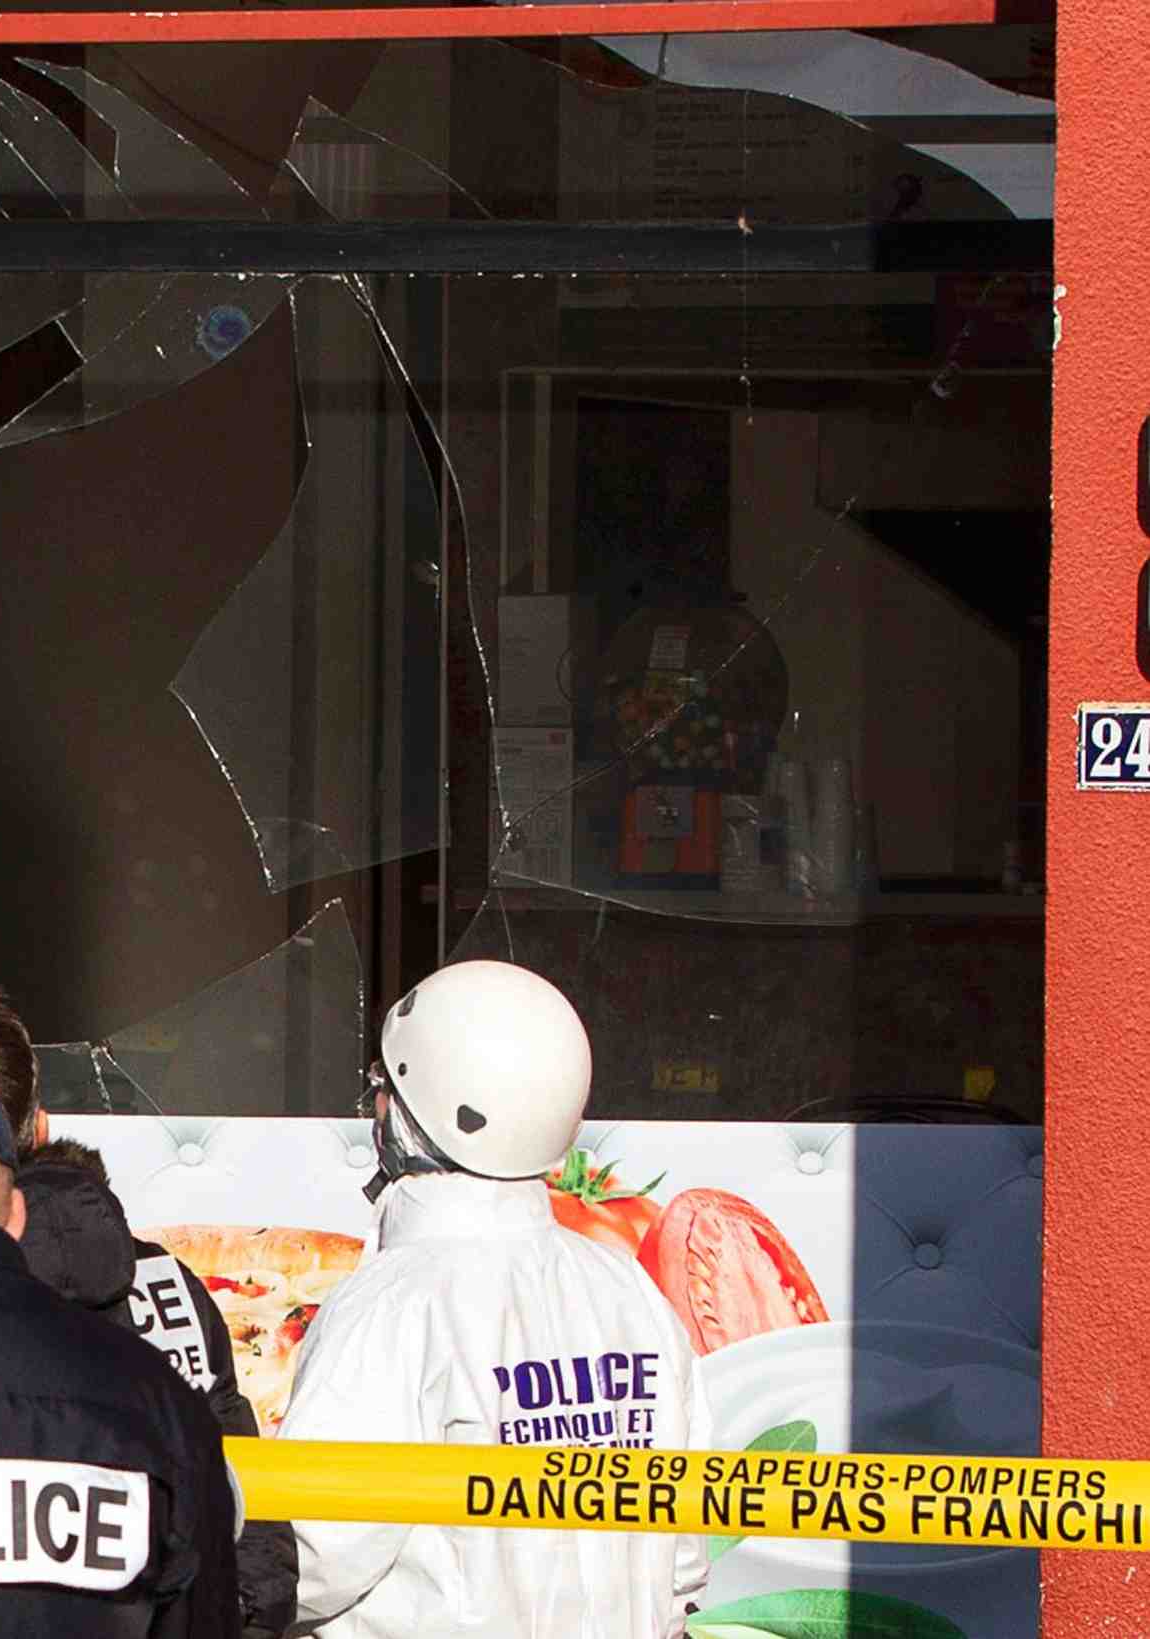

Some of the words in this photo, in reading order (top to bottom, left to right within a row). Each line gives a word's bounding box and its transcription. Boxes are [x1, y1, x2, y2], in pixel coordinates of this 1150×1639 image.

[1090, 717, 1150, 778] 24
[628, 1408, 654, 1433] ET
[543, 1451, 631, 1479] SDIS
[647, 1455, 688, 1481] 69
[702, 1456, 1107, 1499] SAPEURS-POMPIERS
[466, 1475, 677, 1524] DANGER
[702, 1485, 766, 1528] NE
[791, 1489, 886, 1534] PAS
[911, 1495, 1143, 1544] FRANCHI
